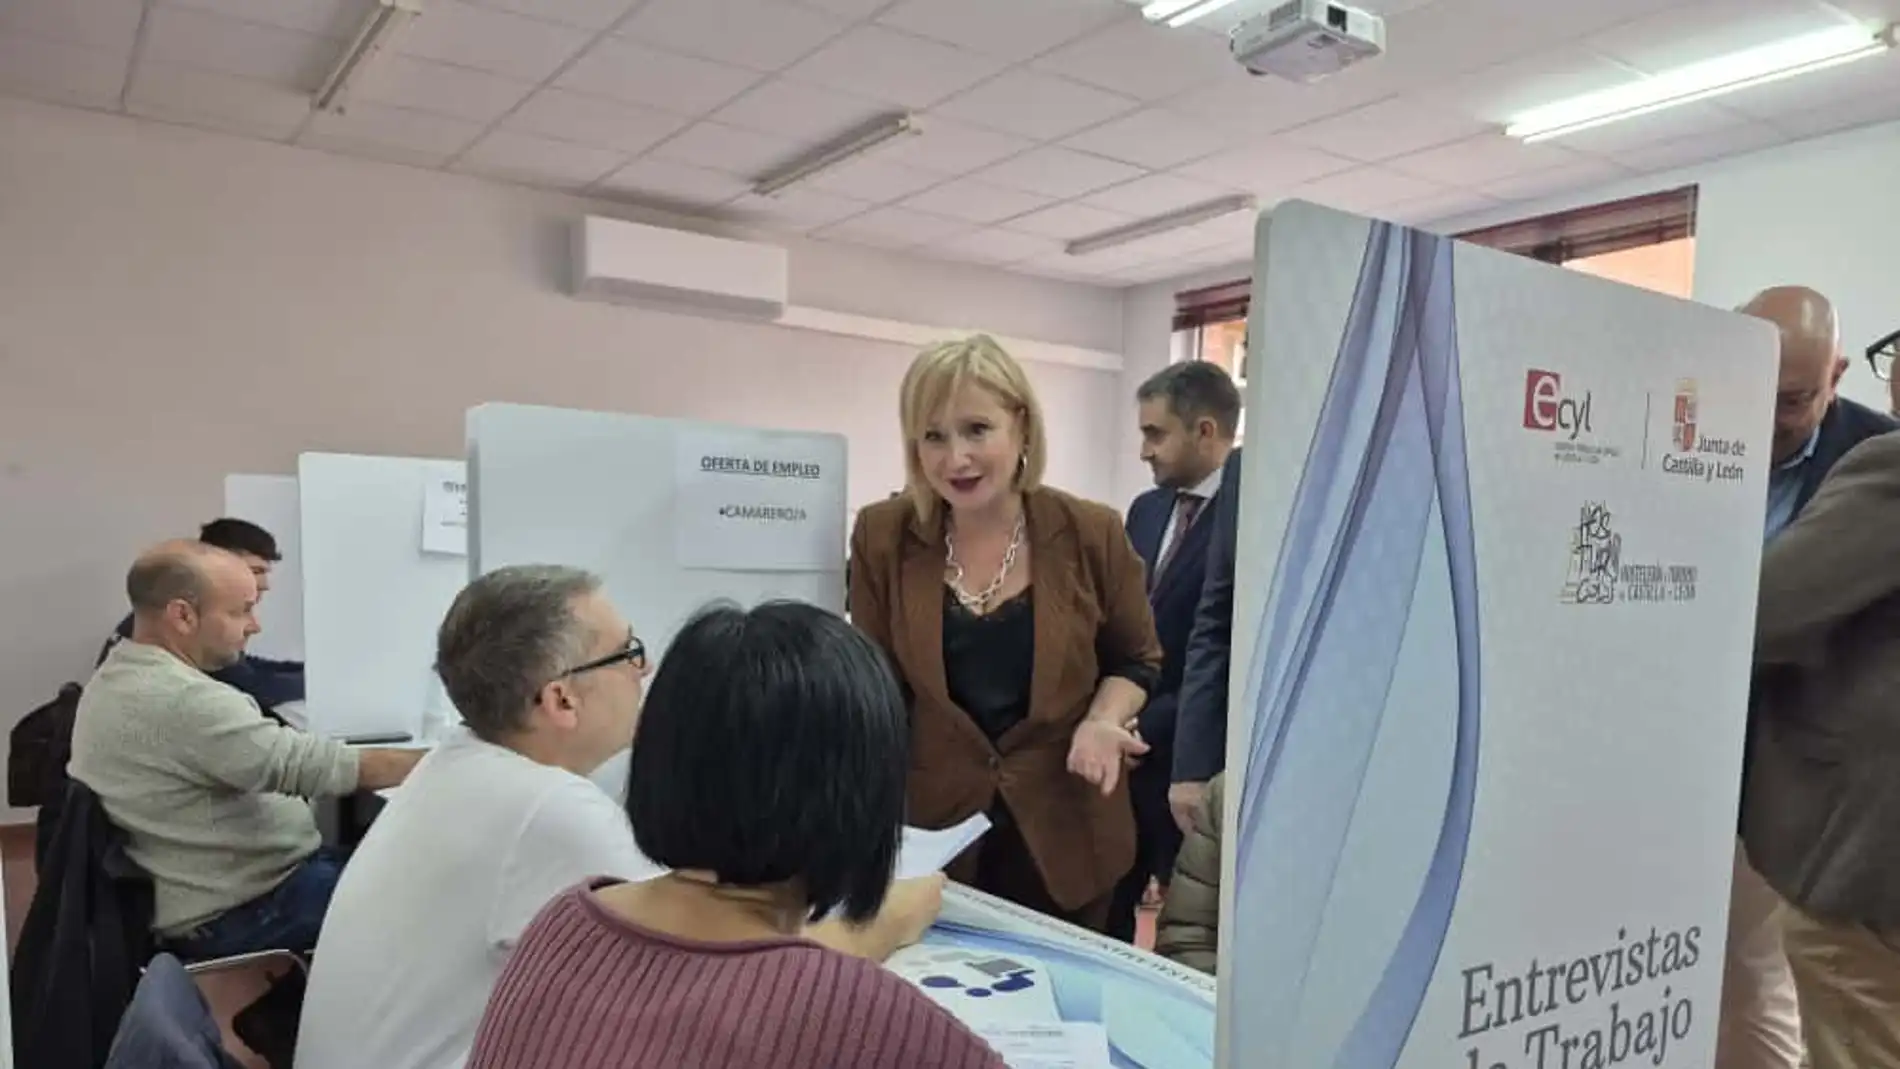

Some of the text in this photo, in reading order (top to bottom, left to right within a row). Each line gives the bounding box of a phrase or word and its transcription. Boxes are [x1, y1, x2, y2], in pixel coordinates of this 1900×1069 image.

[1697, 435, 1746, 456] Junta de
[701, 456, 820, 476] OFERTA DE EMPLEO
[1662, 453, 1744, 482] Castilla y León
[1458, 926, 1701, 1038] Entrevistas
[1525, 986, 1692, 1069] Trabajo
